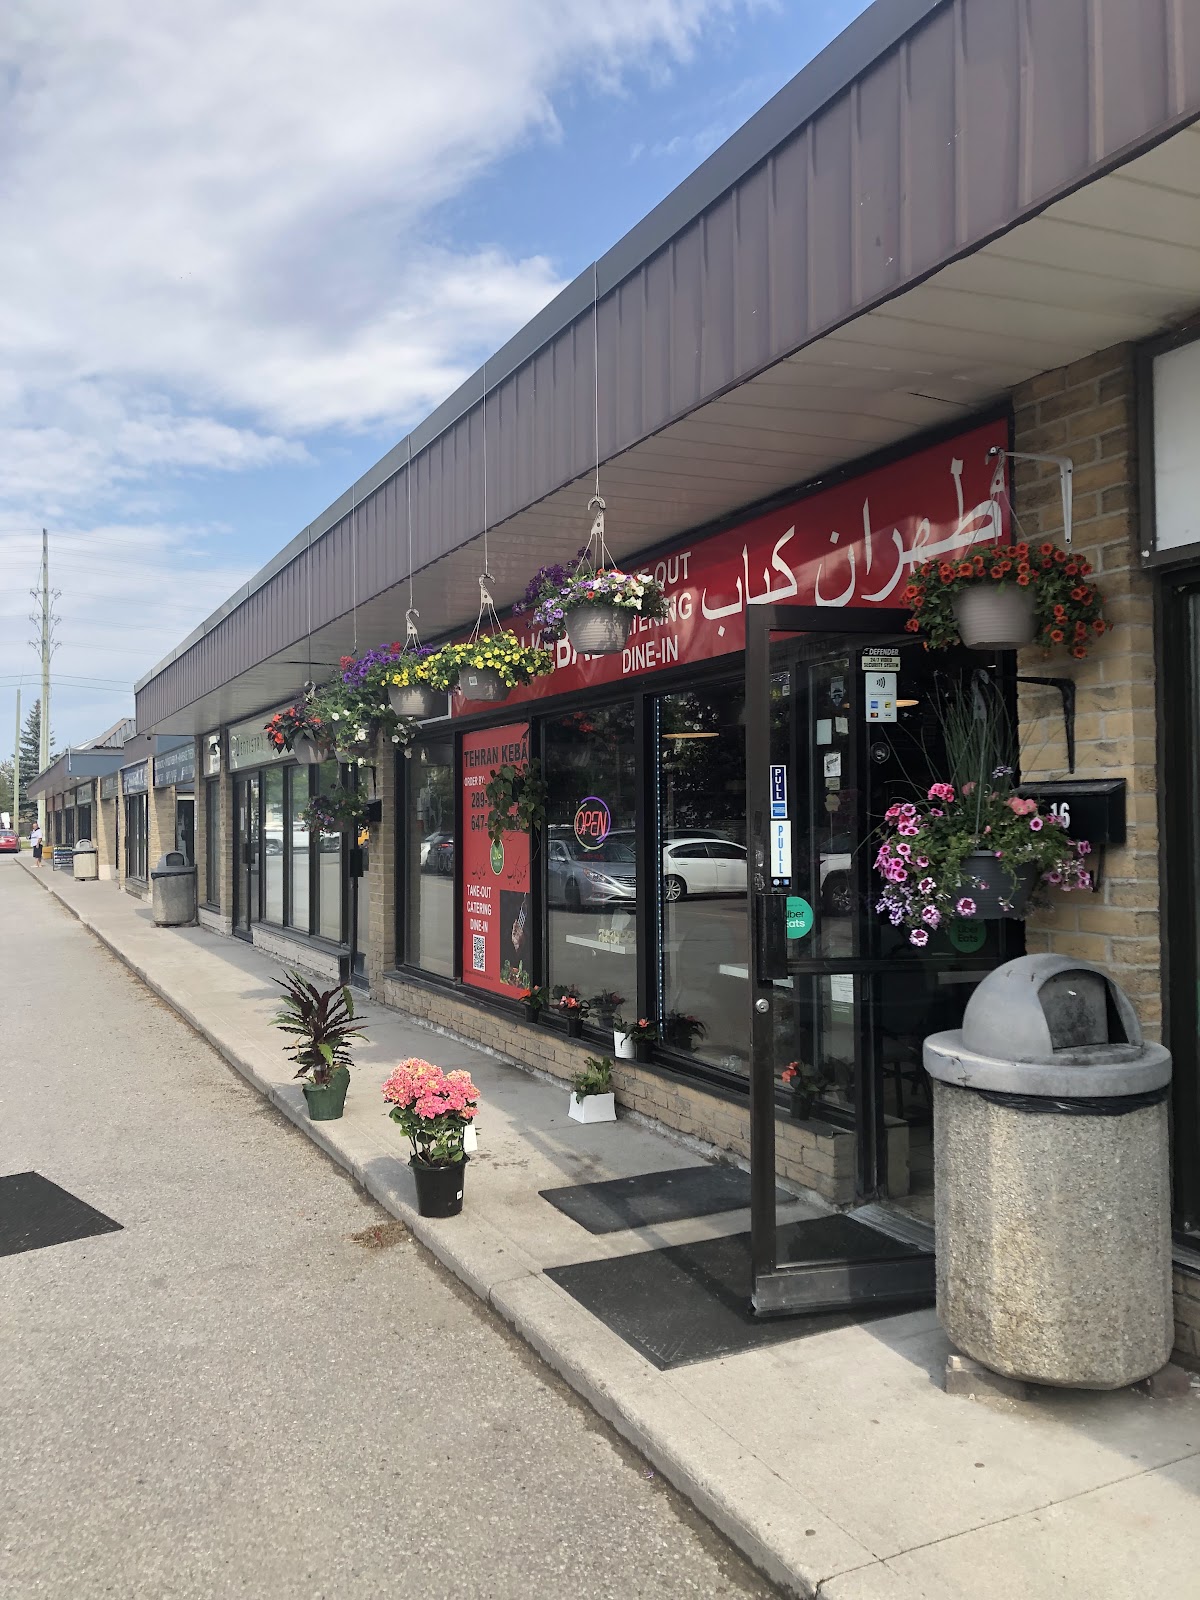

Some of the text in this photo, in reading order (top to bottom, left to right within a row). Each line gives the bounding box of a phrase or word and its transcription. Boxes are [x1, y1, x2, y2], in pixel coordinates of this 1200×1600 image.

[622, 634, 679, 674] DINE-IN
[868, 648, 899, 656] DEFENDER
[464, 746, 499, 767] TEHRAN
[464, 776, 479, 787] ORDER
[774, 768, 782, 800] PULL
[576, 810, 607, 837] OPEN
[1050, 802, 1071, 829] 16
[466, 884, 492, 899] TAKE-OUT
[466, 901, 492, 916] CATERING
[469, 918, 489, 933] DINE-IN
